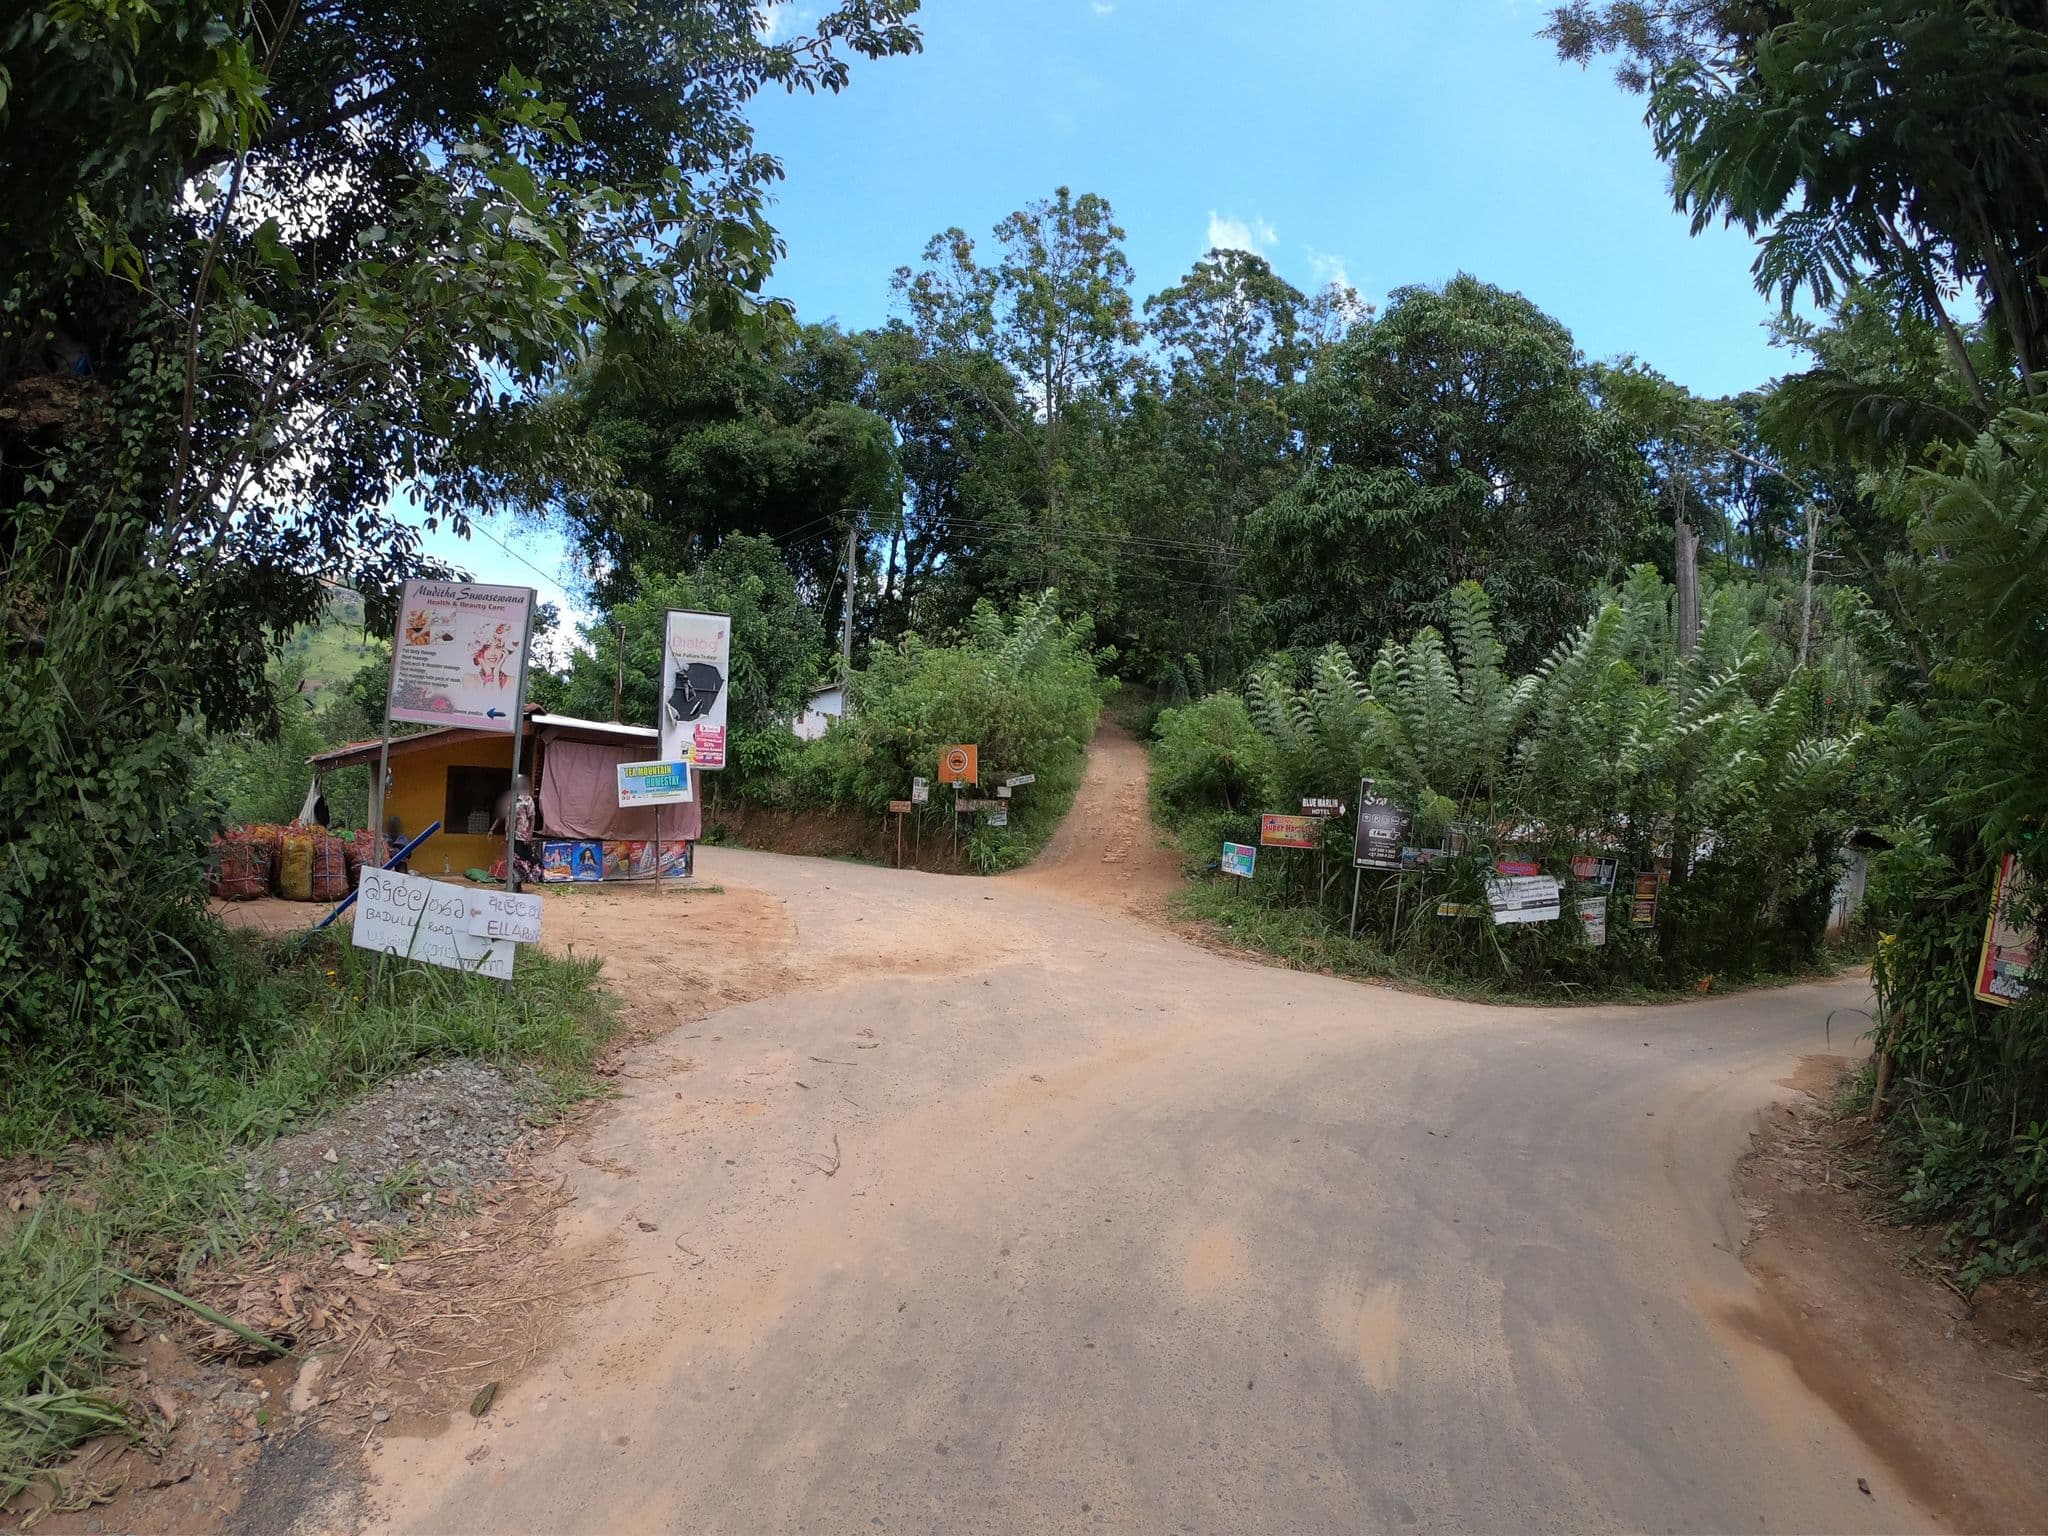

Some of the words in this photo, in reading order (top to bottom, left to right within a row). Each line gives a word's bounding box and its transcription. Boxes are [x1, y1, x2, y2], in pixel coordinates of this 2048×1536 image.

[413, 585, 456, 598] Muditha
[426, 599, 451, 607] Health
[459, 602, 487, 610] Beauty
[672, 636, 718, 653] Dialog
[646, 776, 680, 787] HOMESTAY
[1302, 797, 1316, 807] BLUE
[1264, 823, 1283, 833] Super
[366, 908, 421, 928] BADULL
